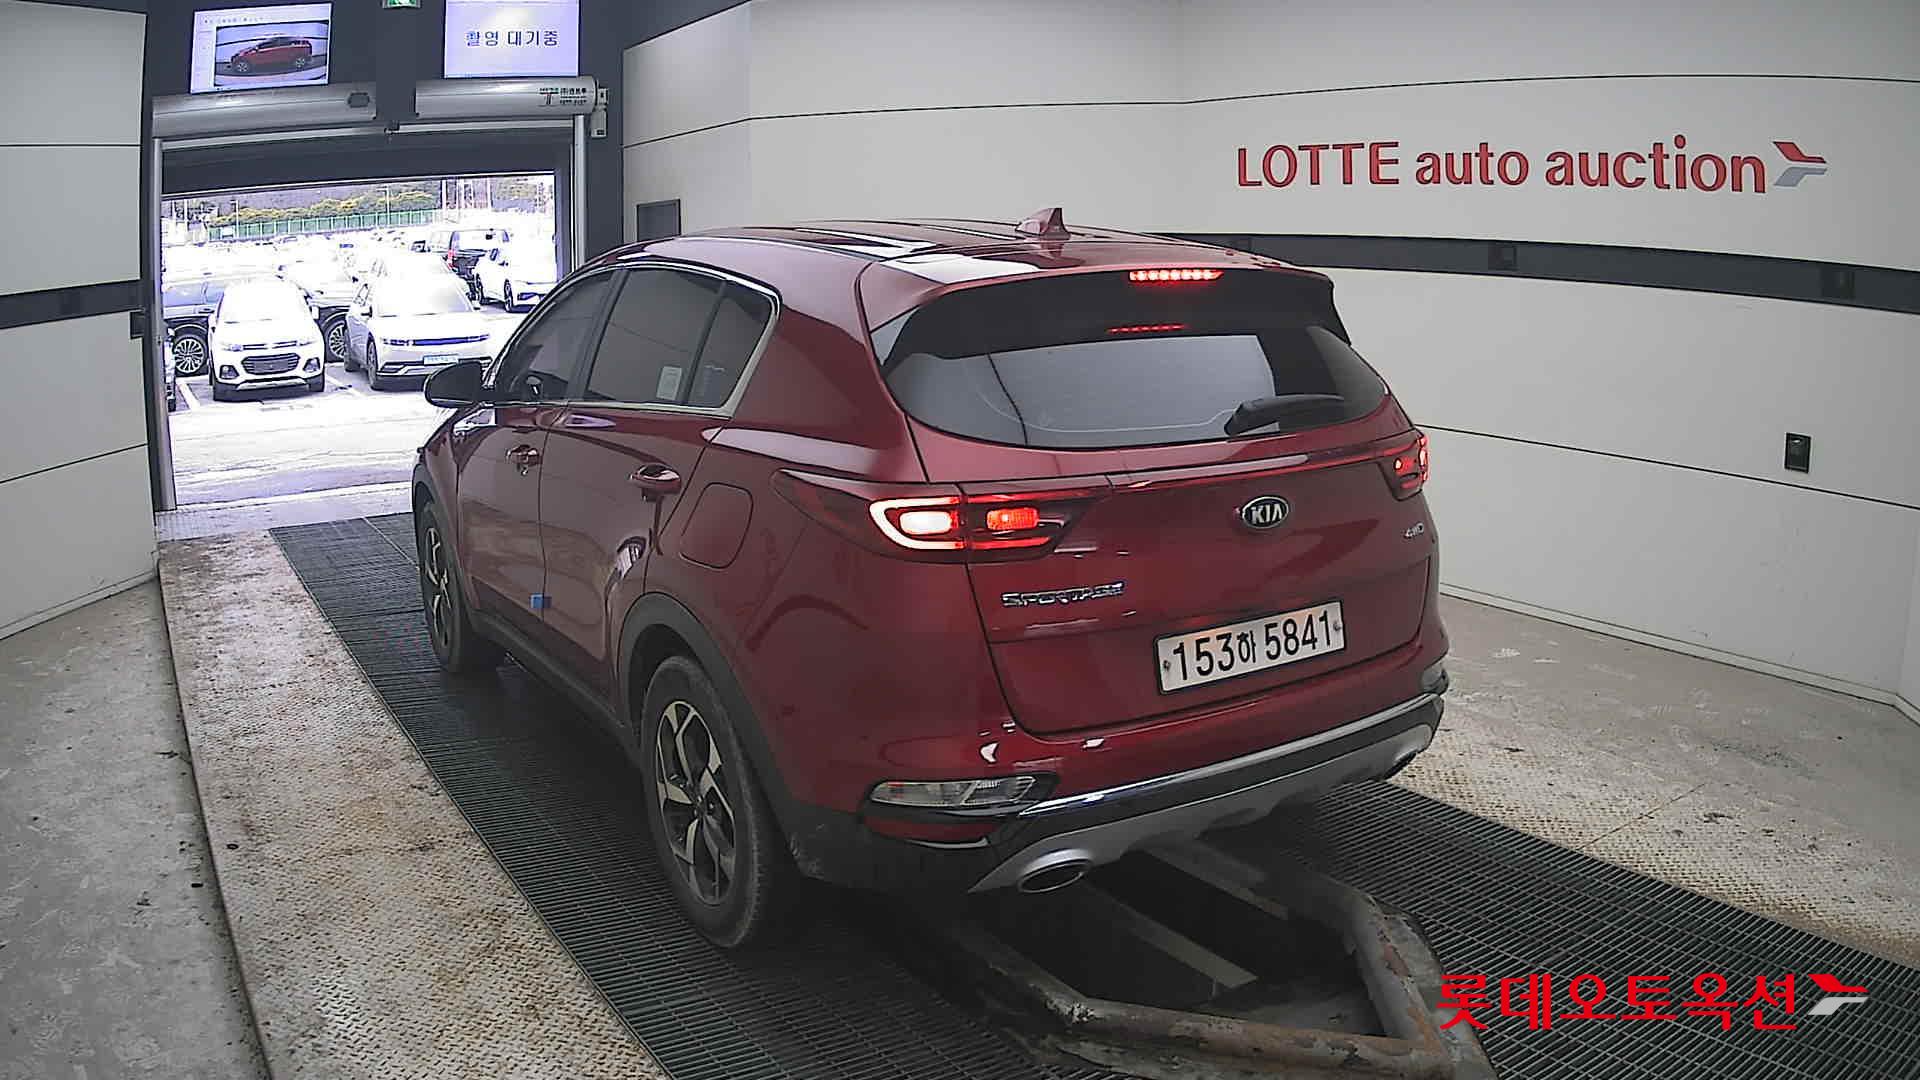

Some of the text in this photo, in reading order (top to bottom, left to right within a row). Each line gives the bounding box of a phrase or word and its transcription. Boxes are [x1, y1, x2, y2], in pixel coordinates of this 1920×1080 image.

[465, 30, 558, 47] 촬영 대기중
[1238, 134, 1766, 194] LOTTE auto auction
[1251, 502, 1284, 526] KIA
[1172, 610, 1332, 681] 153하 5841
